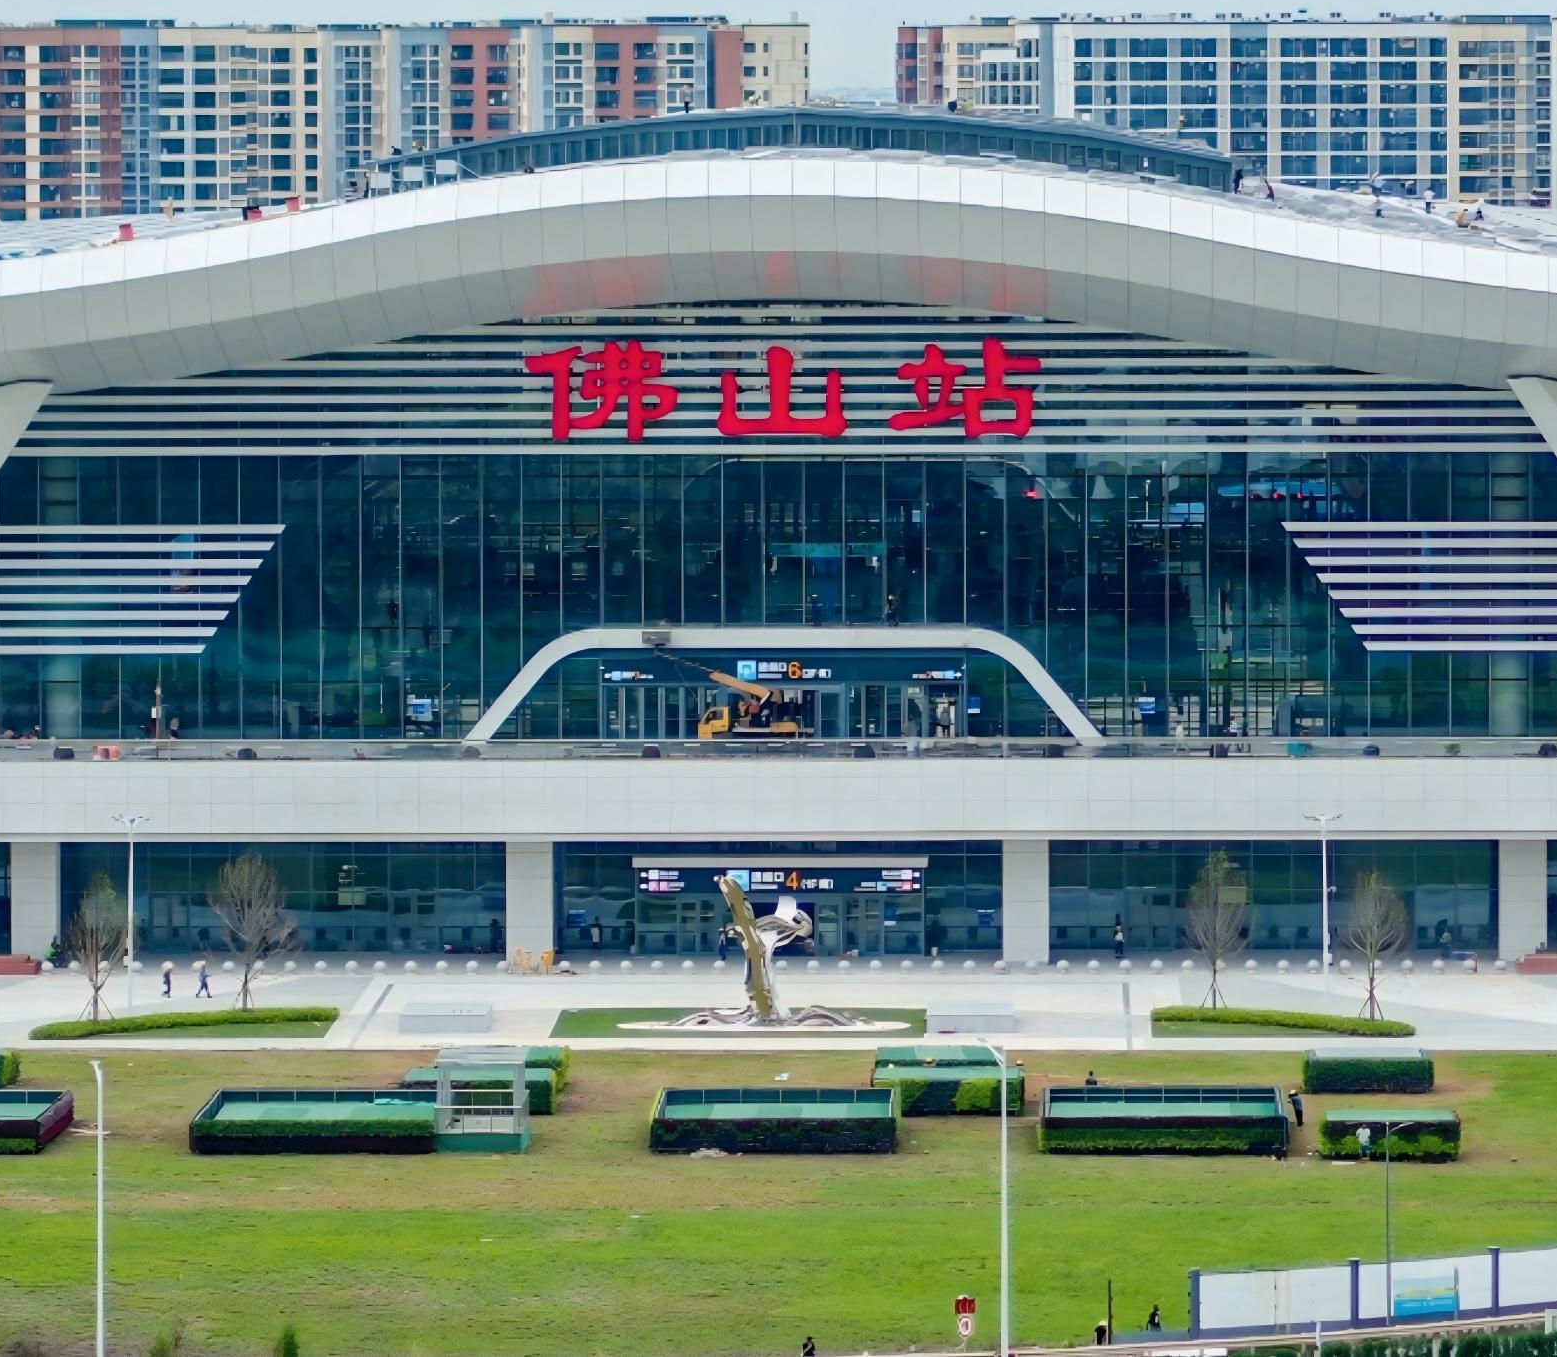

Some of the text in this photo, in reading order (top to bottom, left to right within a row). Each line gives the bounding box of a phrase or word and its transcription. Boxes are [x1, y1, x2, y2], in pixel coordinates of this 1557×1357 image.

[525, 337, 1041, 442] 佛山站
[788, 661, 802, 678] 6
[785, 871, 799, 890] 4
